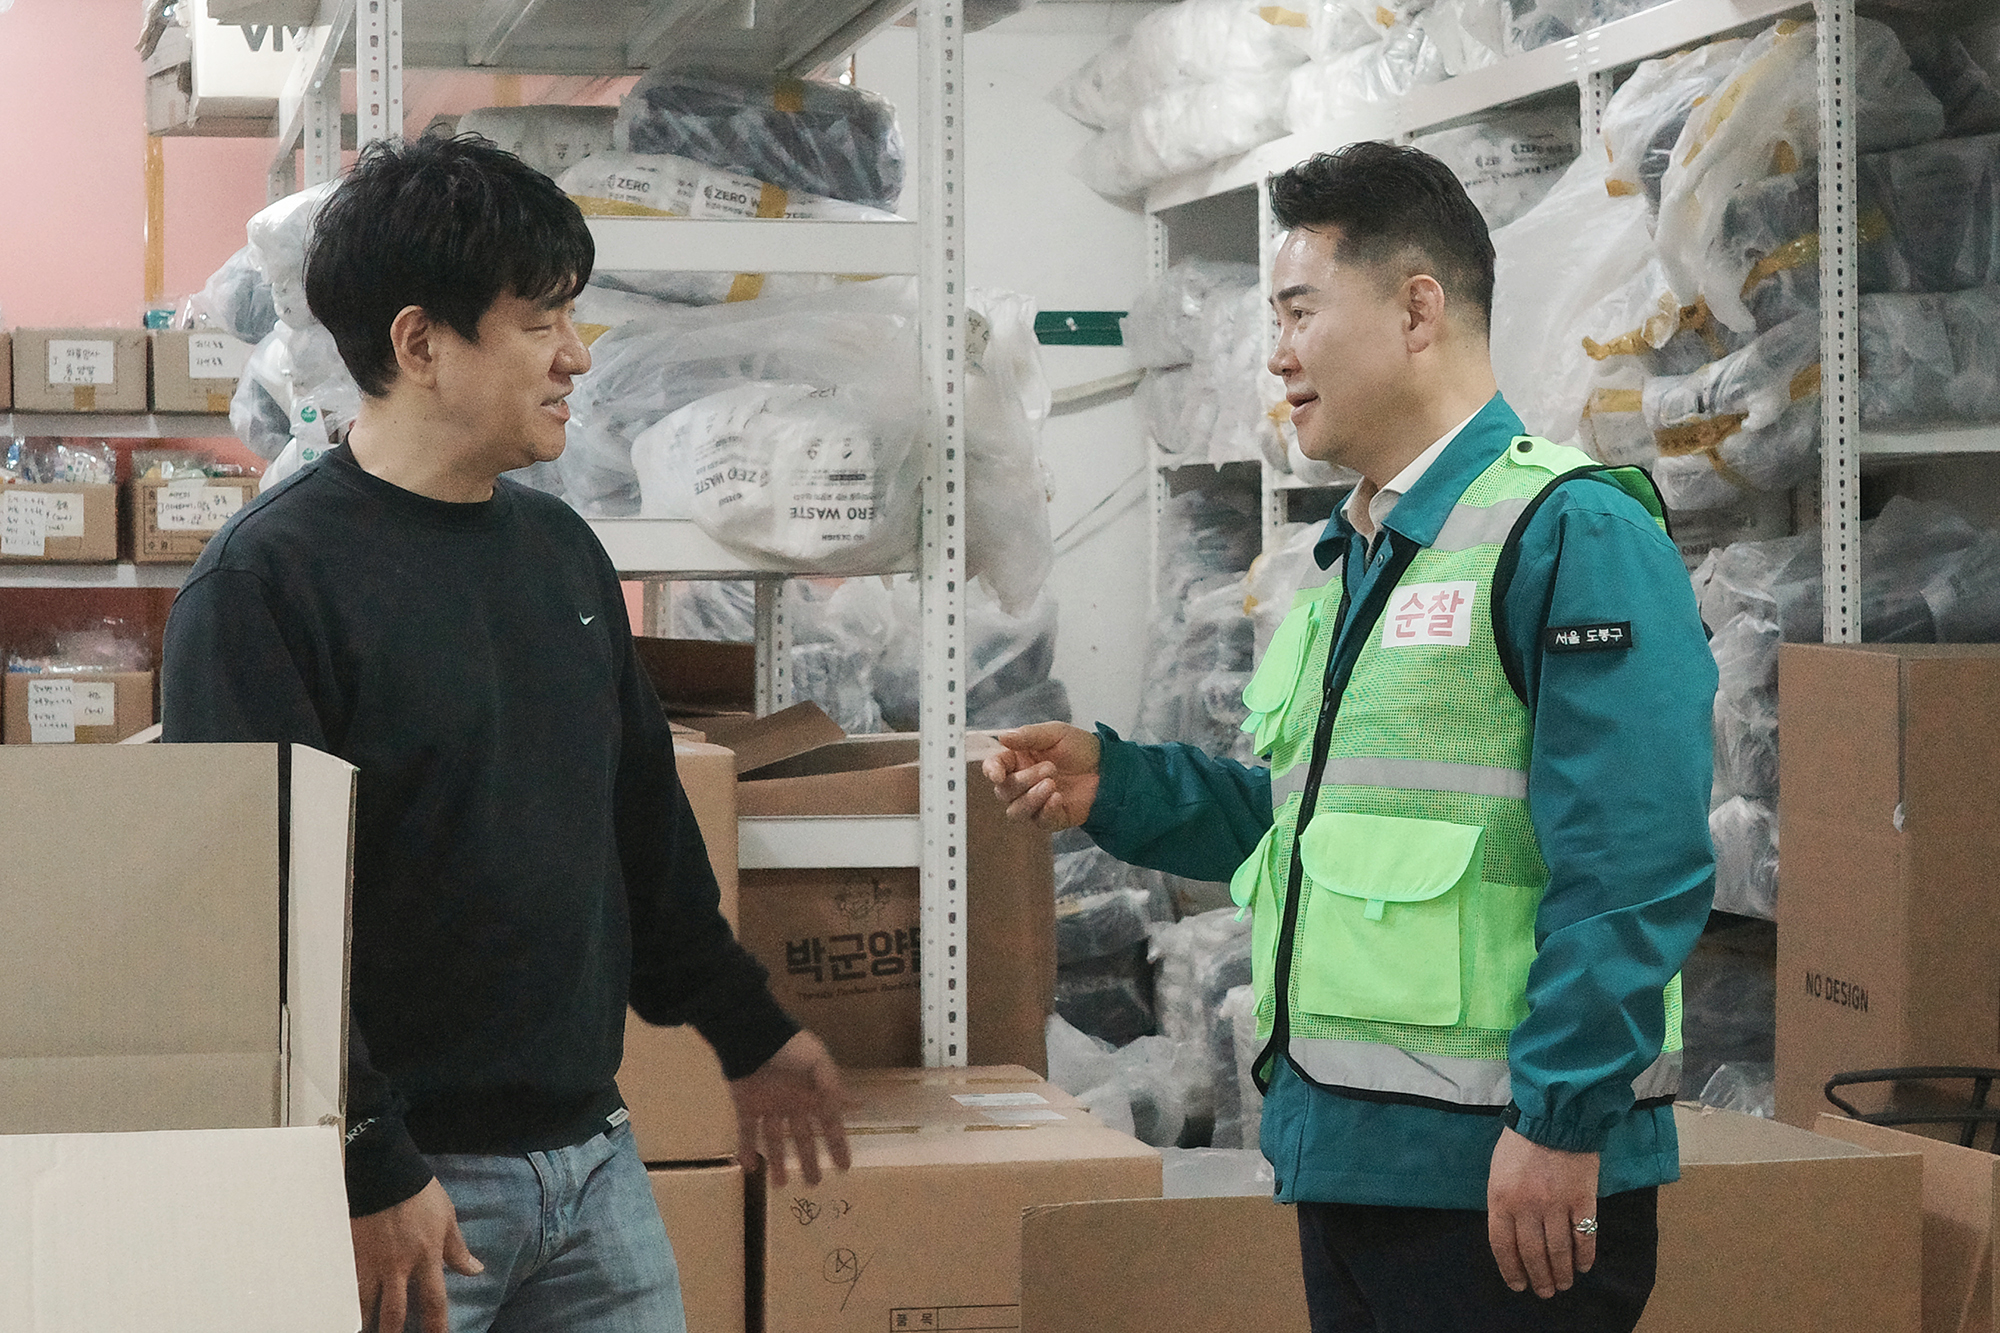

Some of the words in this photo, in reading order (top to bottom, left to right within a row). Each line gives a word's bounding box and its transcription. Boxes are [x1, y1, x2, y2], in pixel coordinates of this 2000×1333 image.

[617, 178, 650, 192] ZERO
[714, 188, 747, 204] ZERO
[694, 472, 725, 495] WASTE
[790, 507, 841, 520] WASTE
[1395, 589, 1465, 639] 순찰
[1555, 631, 1581, 646] 서울
[1586, 628, 1624, 643] 도봉구
[1806, 971, 1821, 998] NO
[1825, 976, 1869, 1013] DESIGN
